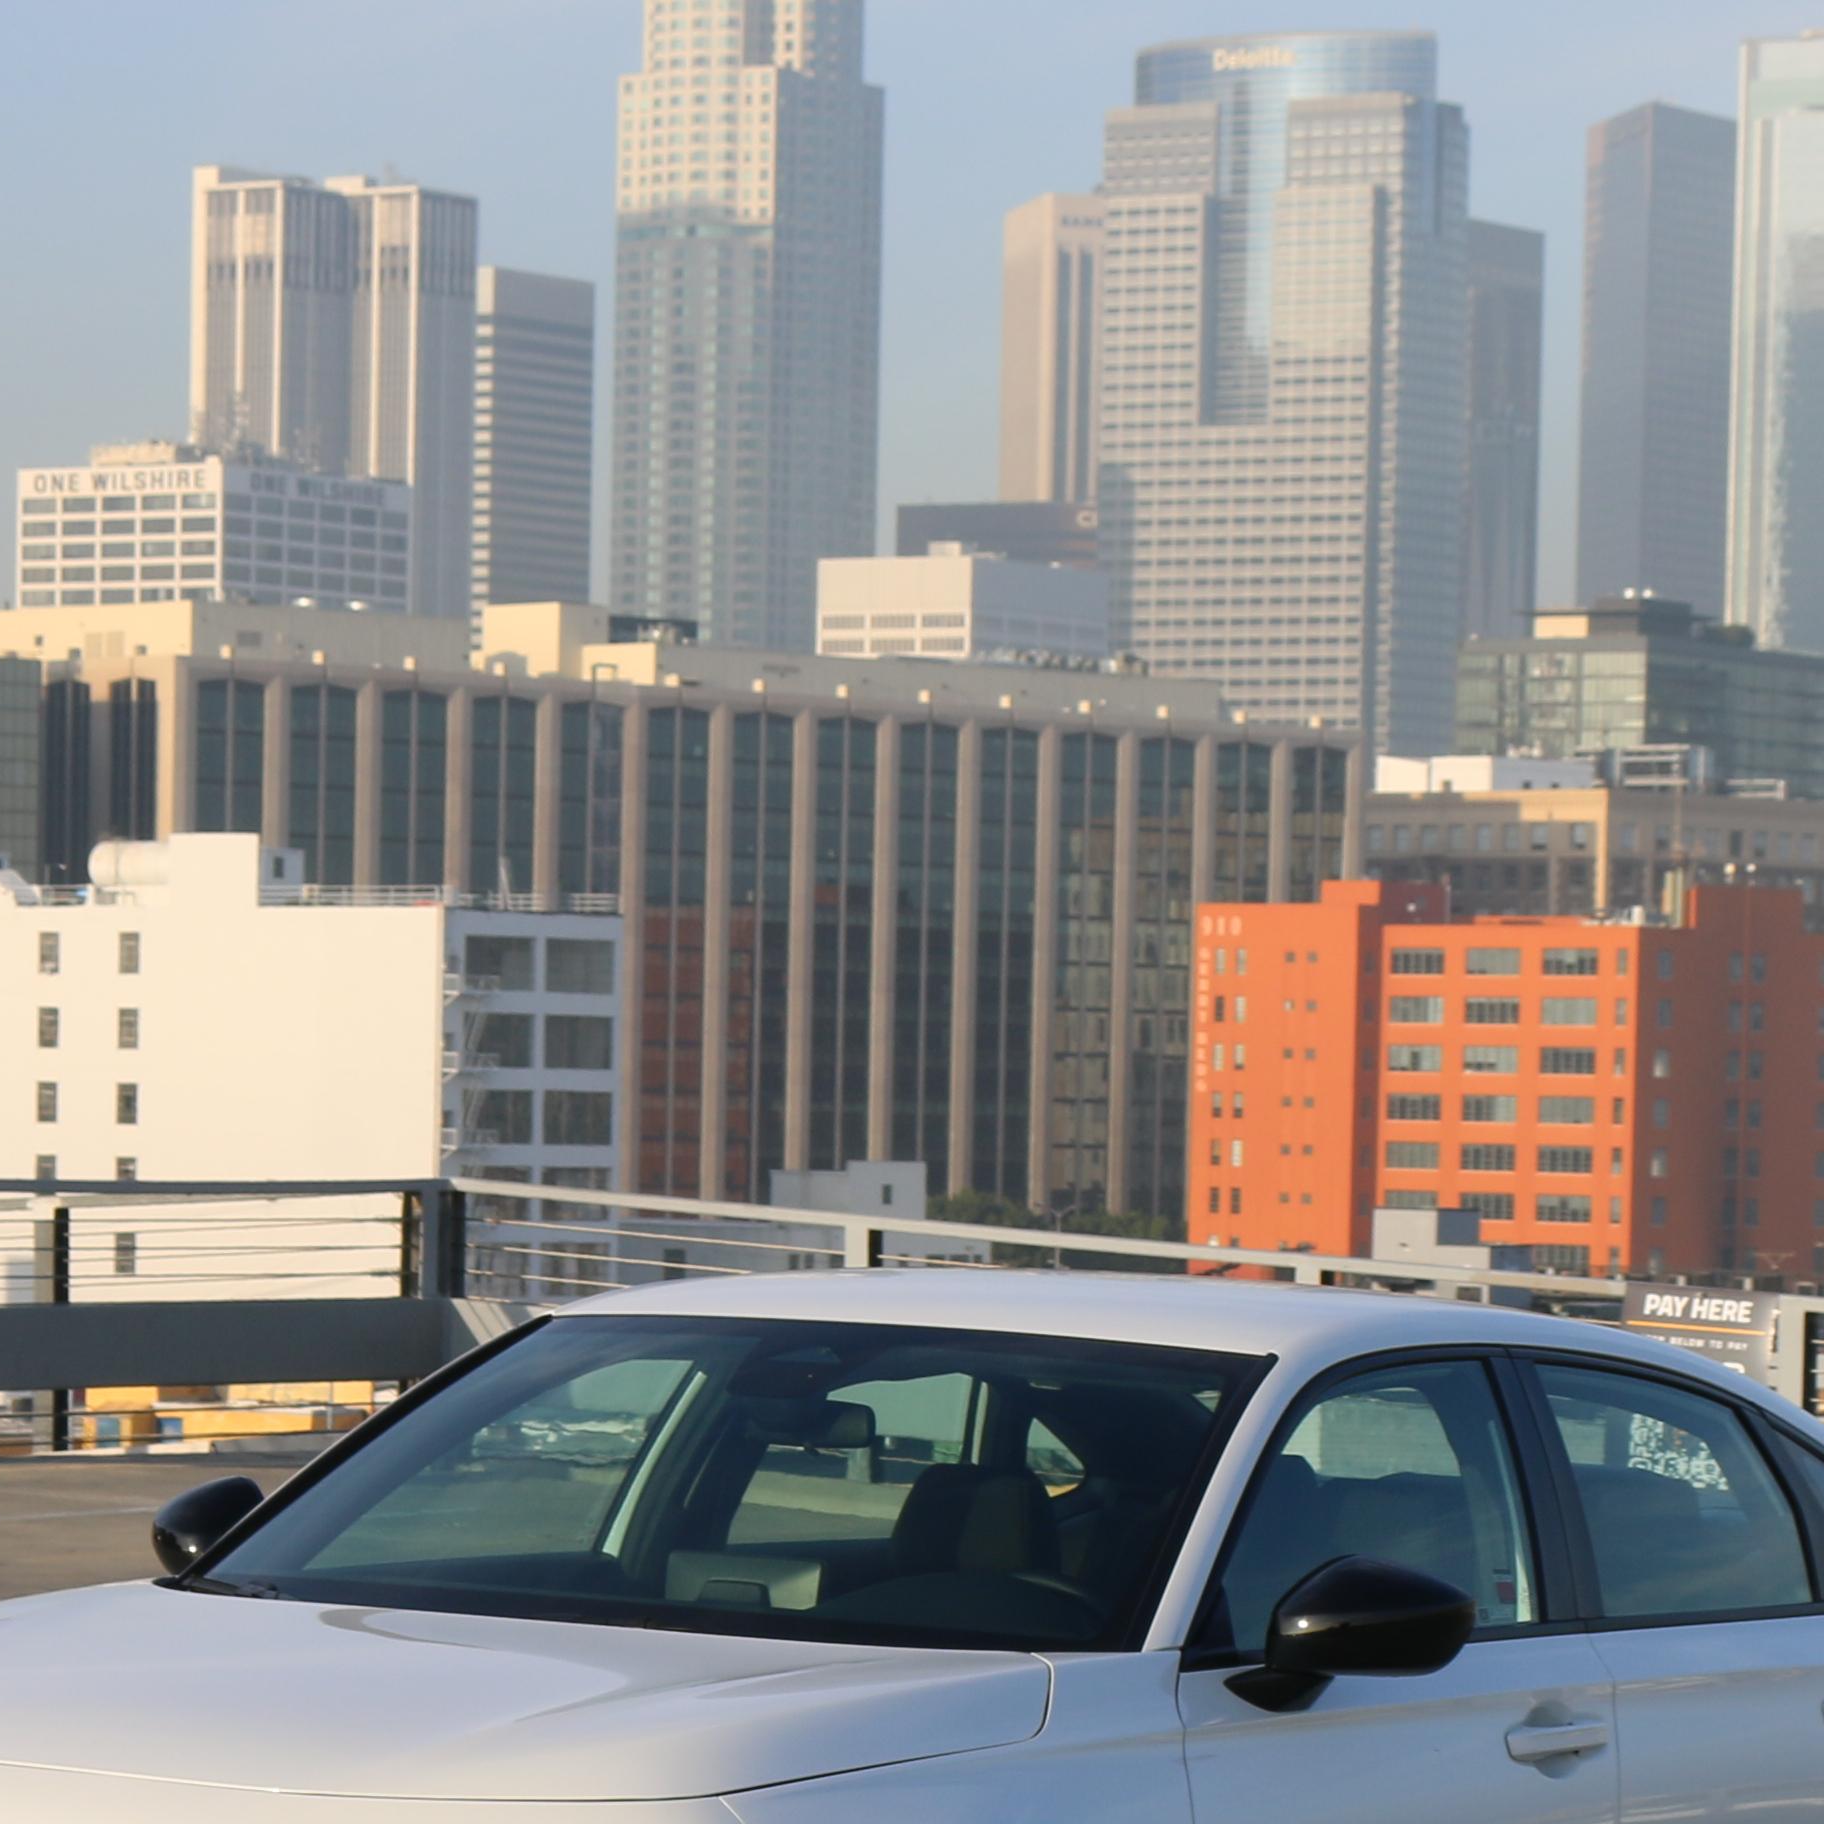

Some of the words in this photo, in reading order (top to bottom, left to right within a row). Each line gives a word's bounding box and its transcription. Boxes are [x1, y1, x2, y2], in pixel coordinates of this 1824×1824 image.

[34, 474, 80, 493] ONE
[92, 468, 206, 491] WILSHIRE
[1643, 1293, 1688, 1318] PAY
[1690, 1296, 1754, 1323] HERE
